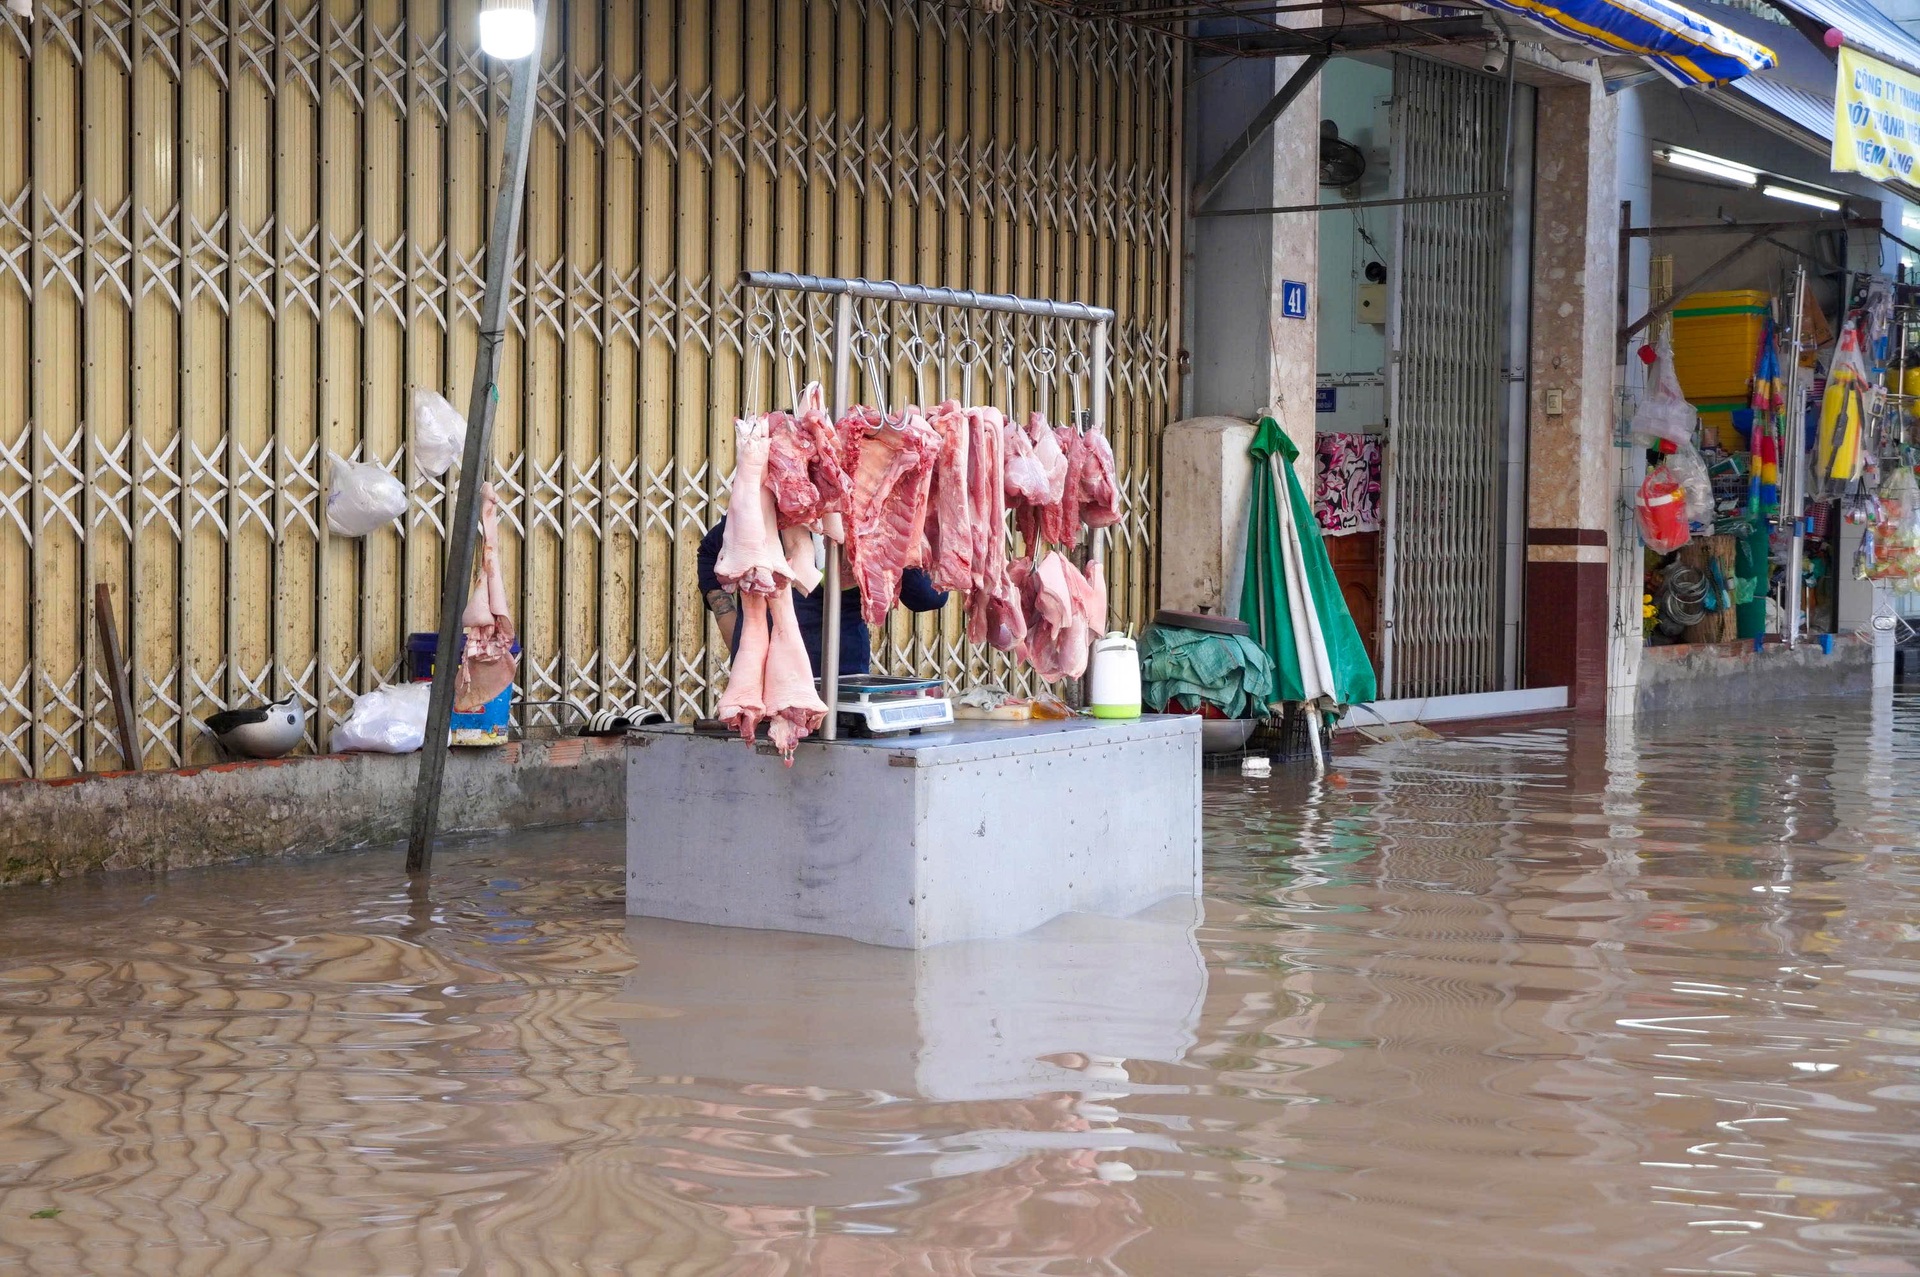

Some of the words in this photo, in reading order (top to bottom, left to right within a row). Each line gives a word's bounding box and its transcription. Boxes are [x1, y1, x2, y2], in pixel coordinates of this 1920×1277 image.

[1855, 68, 1882, 98] CÔNG
[1885, 80, 1896, 102] TY
[1289, 287, 1301, 313] 41
